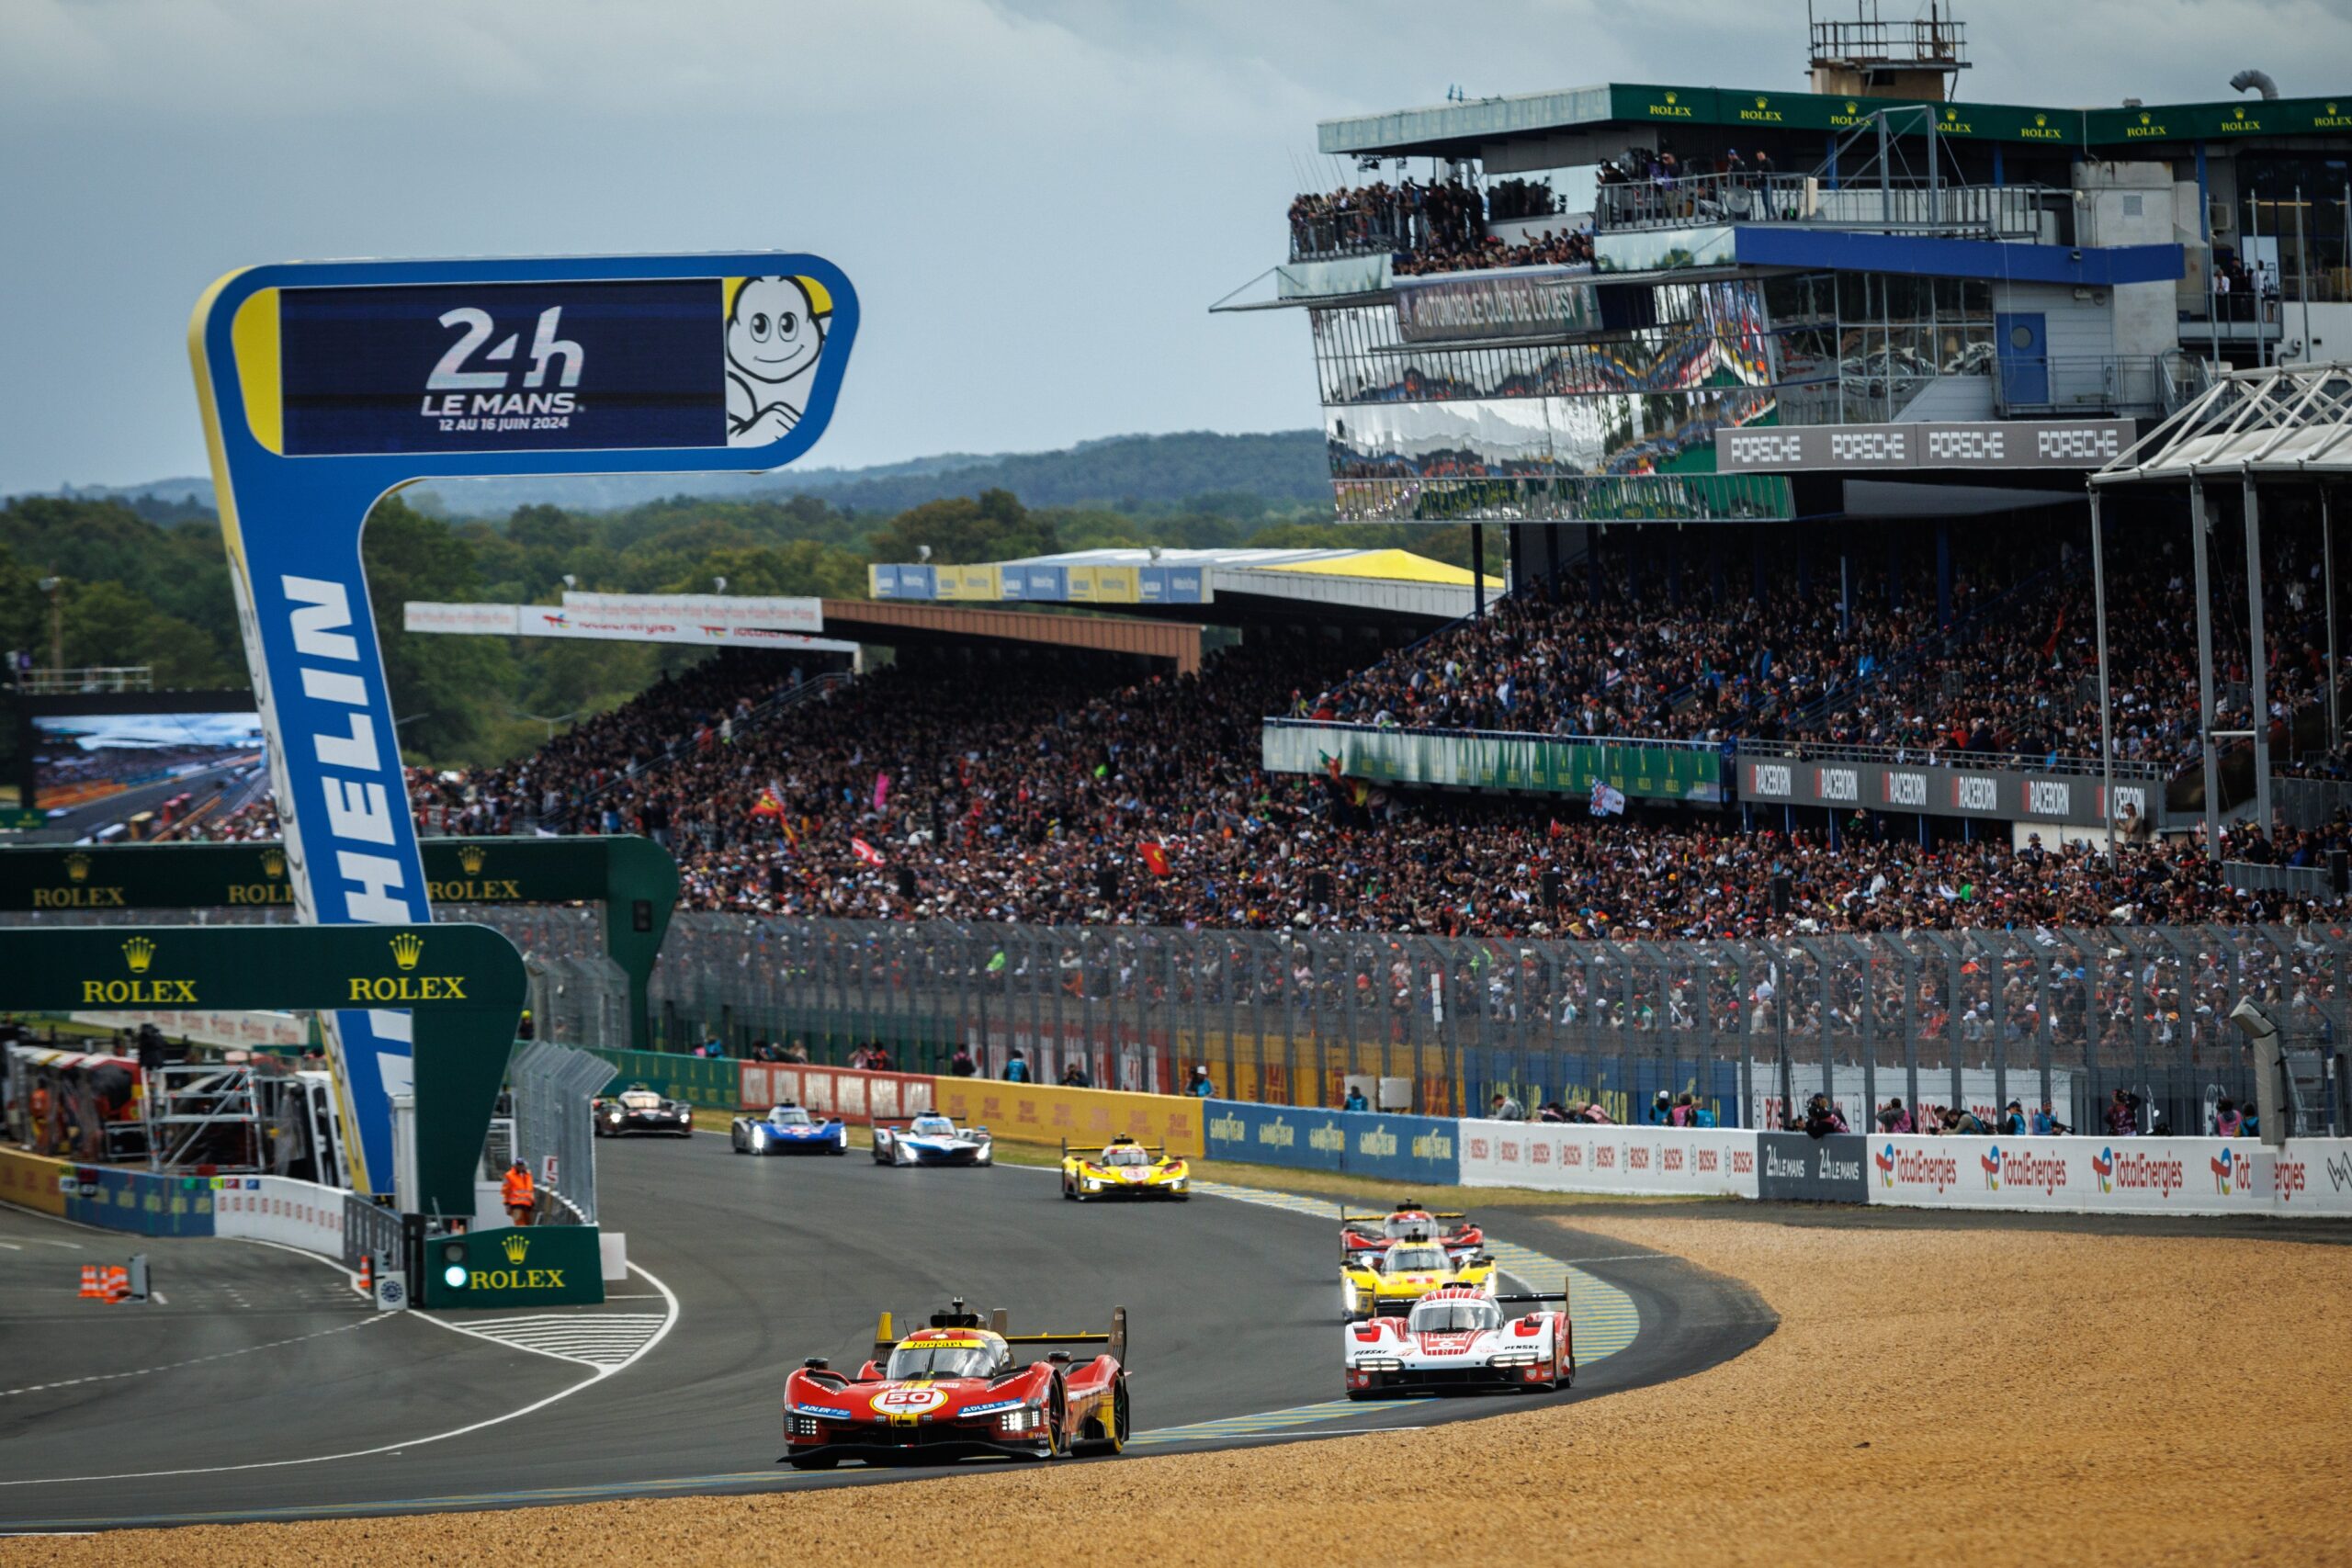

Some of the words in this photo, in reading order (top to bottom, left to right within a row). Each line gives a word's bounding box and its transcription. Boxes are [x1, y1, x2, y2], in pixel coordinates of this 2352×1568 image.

[1649, 105, 1691, 118] ROLEX
[1740, 109, 1782, 122] ROLEX
[2314, 116, 2352, 127] ROLEX
[1934, 122, 1972, 133] OLEX
[2021, 128, 2062, 140] ROLEX
[2127, 125, 2166, 138] ROLEX
[2222, 120, 2261, 131] ROLEX
[1416, 291, 1484, 328] AUTOMOBILE
[1483, 289, 1514, 324] CLUB
[1514, 289, 1532, 321] DE
[425, 306, 584, 390] 24h
[421, 395, 467, 416] LE
[470, 392, 576, 416] MANS
[438, 418, 453, 432] 12
[455, 418, 479, 431] AU
[481, 417, 496, 431] 16
[497, 417, 531, 432] JUIN
[531, 416, 570, 430] 2024
[1731, 435, 1801, 462] PORSCHE
[1832, 433, 1905, 460] PORSCHE
[1928, 431, 2005, 459] PORSCHE
[2038, 429, 2119, 458] PORSCHE
[1755, 764, 1792, 796] RACEBORN
[1821, 768, 1858, 802] RACEBORN
[1889, 772, 1927, 806] RACEBORN
[1958, 776, 1996, 811] RACEBORN
[2029, 780, 2070, 816] RACEBORN
[2104, 785, 2145, 820] CEBORN
[33, 886, 126, 908] ROLEX
[228, 884, 295, 904] ROL
[426, 880, 521, 900] ROLEX
[82, 979, 198, 1003] ROLEX
[347, 976, 468, 1001] ROLEX
[1630, 1146, 1649, 1169] BOSCH
[1664, 1148, 1683, 1171] BOSCH
[1699, 1149, 1718, 1172] BOSCH
[1733, 1151, 1753, 1174] BOSCH
[1779, 1159, 1787, 1178] LE
[1787, 1159, 1805, 1179] MANS
[1832, 1161, 1840, 1179] LE
[1840, 1161, 1860, 1181] MANS
[1895, 1149, 1957, 1194] TotalEnergies
[2001, 1150, 2066, 1196] TotalEnergies
[2114, 1150, 2183, 1198] TotalEnergies
[469, 1269, 566, 1291] ROLEX
[800, 1404, 831, 1414] ADLER
[887, 1392, 932, 1404] 50
[962, 1403, 996, 1413] ADLER
